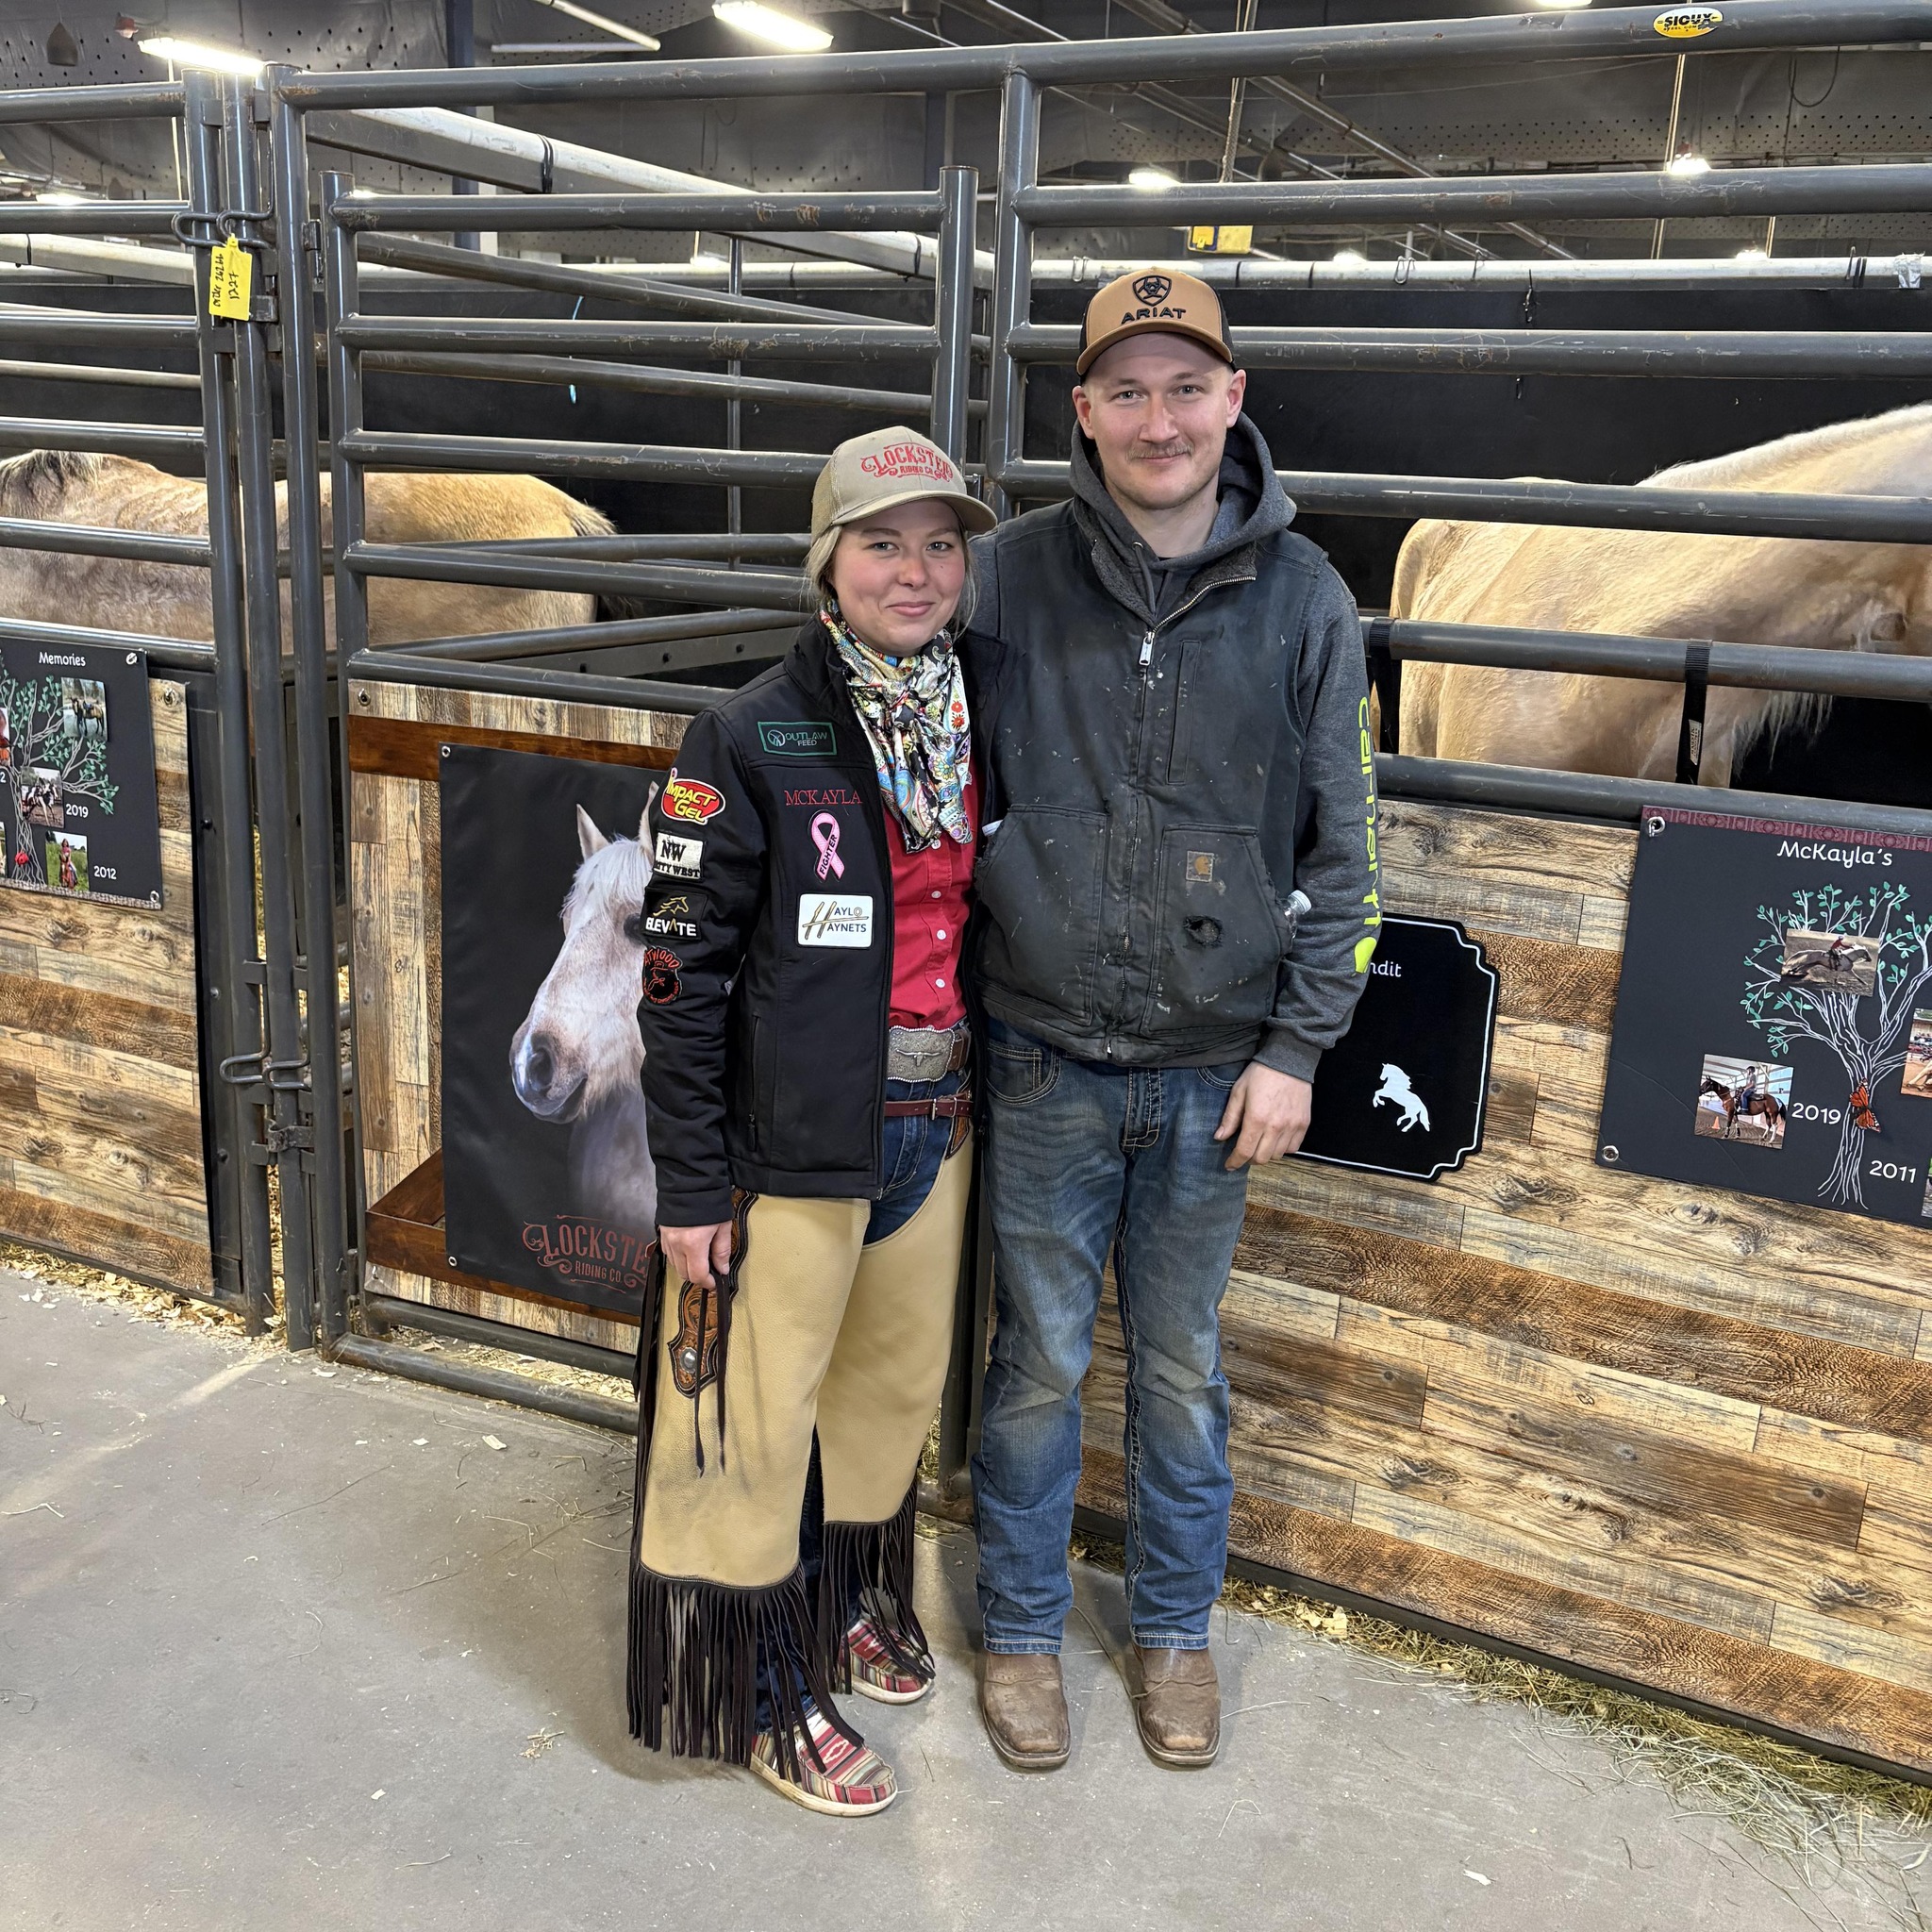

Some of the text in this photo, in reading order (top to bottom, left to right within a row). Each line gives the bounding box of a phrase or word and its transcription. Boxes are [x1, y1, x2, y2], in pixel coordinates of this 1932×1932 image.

[1664, 13, 1712, 26] SIOUX
[1122, 307, 1187, 325] ARIAT
[39, 651, 86, 667] Memories
[785, 732, 827, 741] OUTLAW
[666, 773, 717, 807] IMPACT
[784, 790, 862, 807] MCKAYLA
[65, 803, 89, 818] 2019
[675, 799, 705, 822] GEL
[660, 839, 687, 862] NW
[820, 834, 837, 874] FIGHTER
[1776, 841, 1893, 868] McKayla's
[93, 865, 117, 880] 2012
[673, 865, 701, 877] WEST
[1370, 959, 1402, 977] ndit
[1791, 1102, 1841, 1124] 2019
[1869, 1160, 1916, 1183] 2011
[522, 1221, 649, 1276] LOCKSTE
[575, 1259, 607, 1280] RIDING
